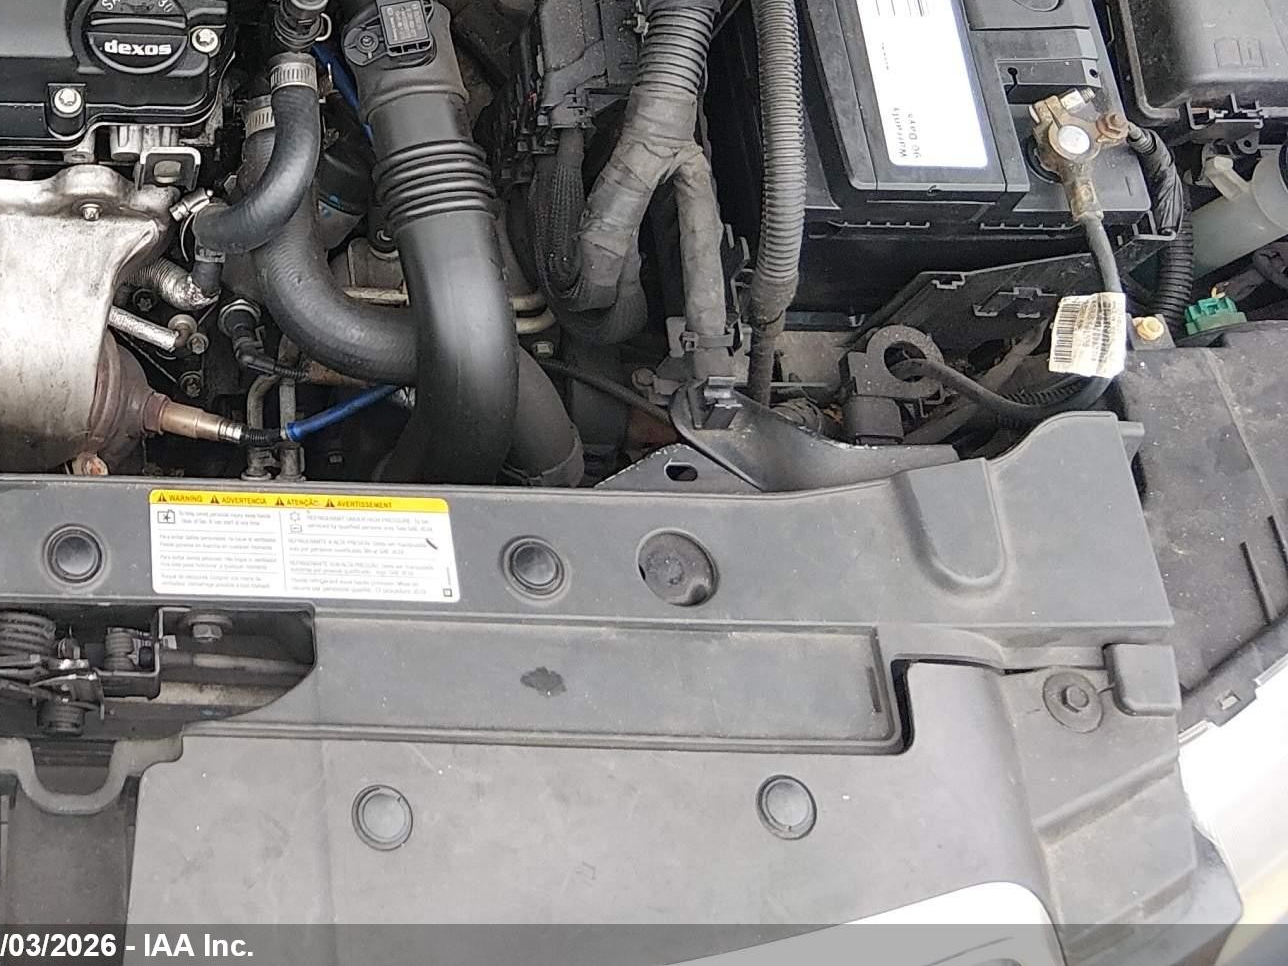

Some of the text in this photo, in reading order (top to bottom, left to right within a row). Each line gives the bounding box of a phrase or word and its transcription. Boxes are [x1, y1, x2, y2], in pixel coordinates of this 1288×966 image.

[104, 39, 172, 56] dexos
[168, 495, 203, 503] WARNING
[221, 497, 267, 505] ADVERTENCIA
[337, 500, 393, 509] AVERTISSEMENT
